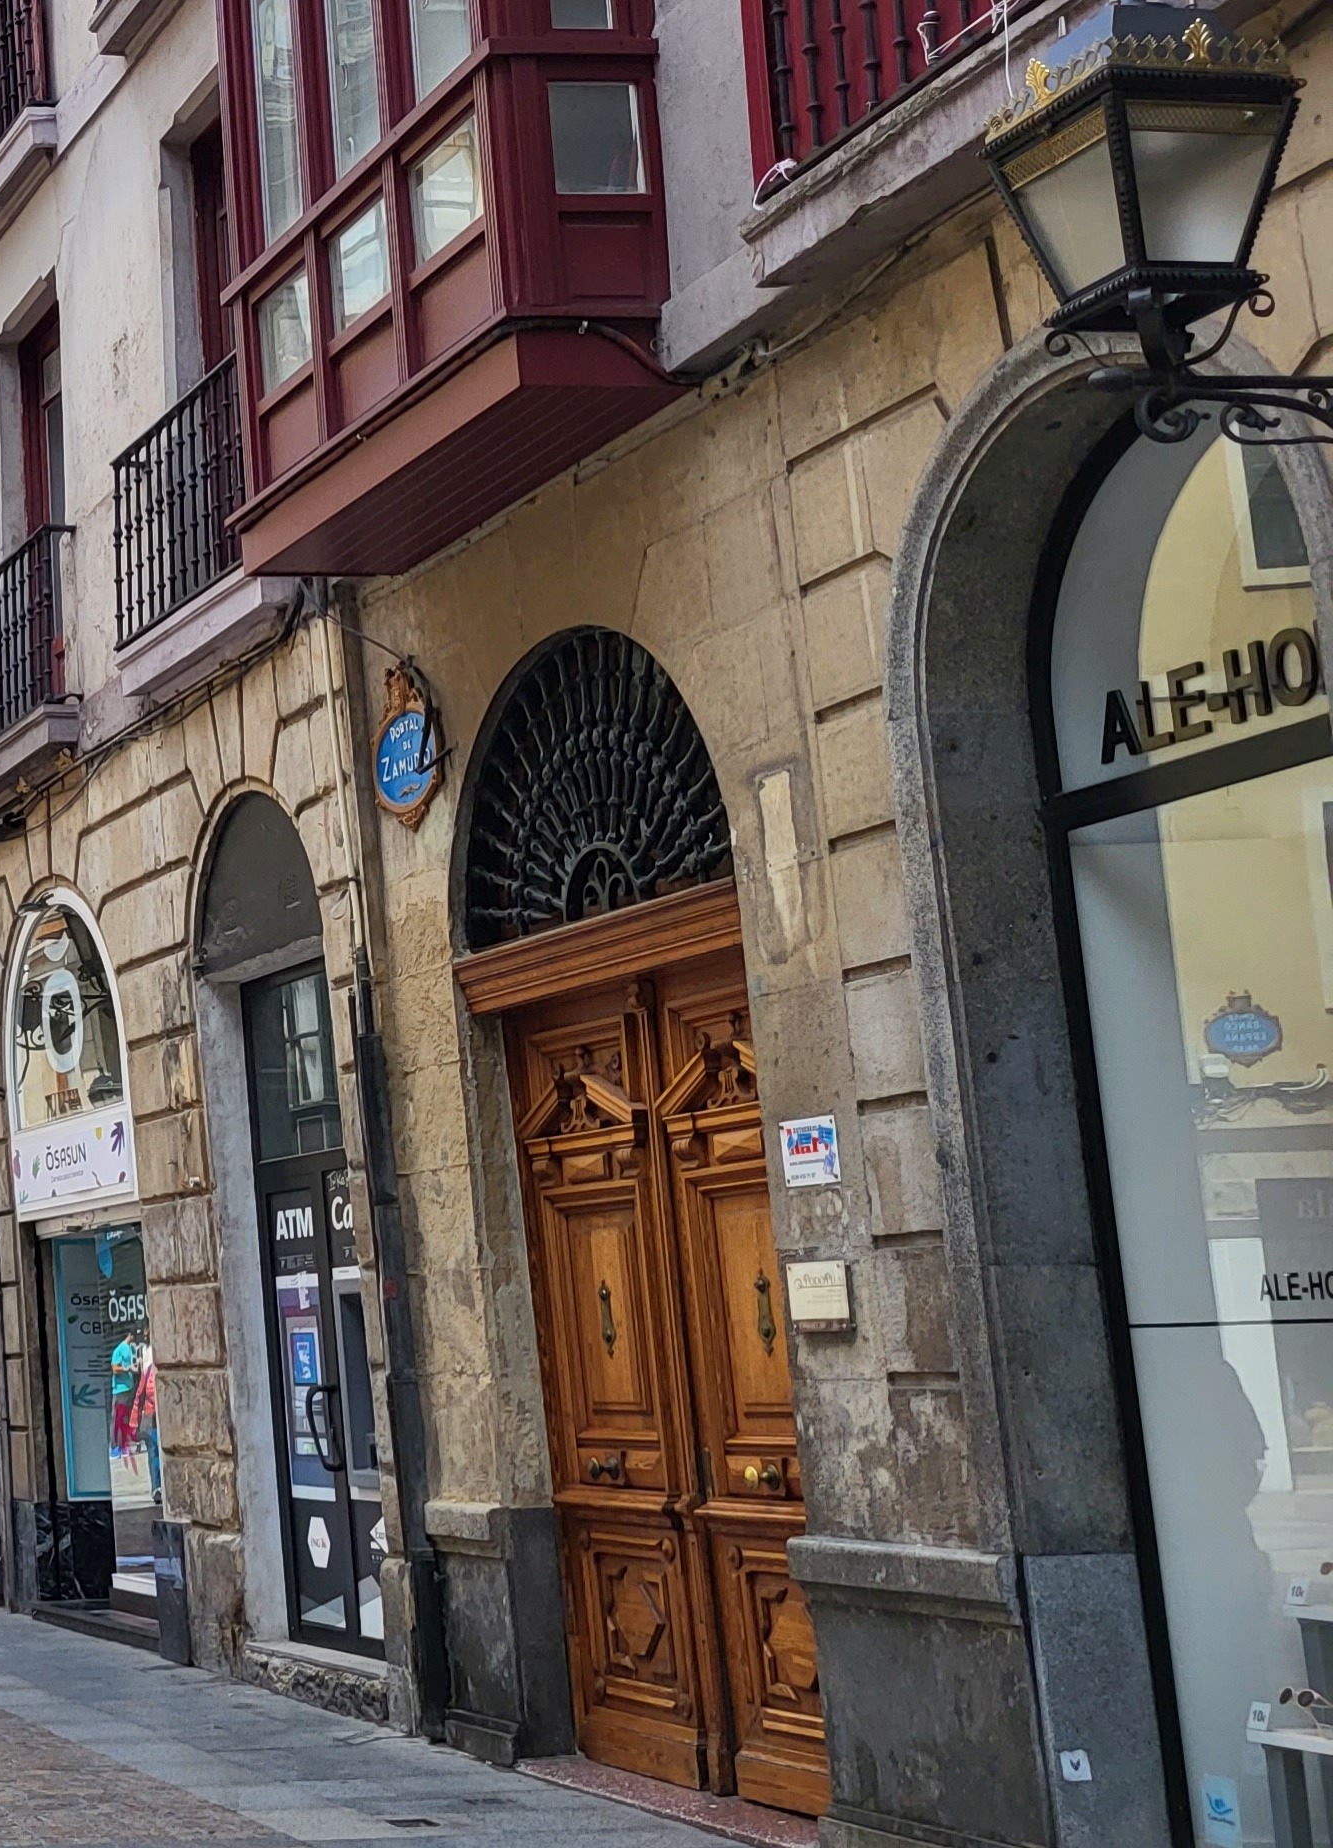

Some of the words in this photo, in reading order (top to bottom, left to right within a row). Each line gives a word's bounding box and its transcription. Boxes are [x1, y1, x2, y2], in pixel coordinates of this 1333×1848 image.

[1101, 620, 1326, 765] ALE-HO
[389, 717, 419, 742] PORTAL
[402, 740, 412, 751] DE
[381, 749, 431, 782] ZAMUDO
[275, 1206, 314, 1241] ATM
[331, 1195, 356, 1237] Ca
